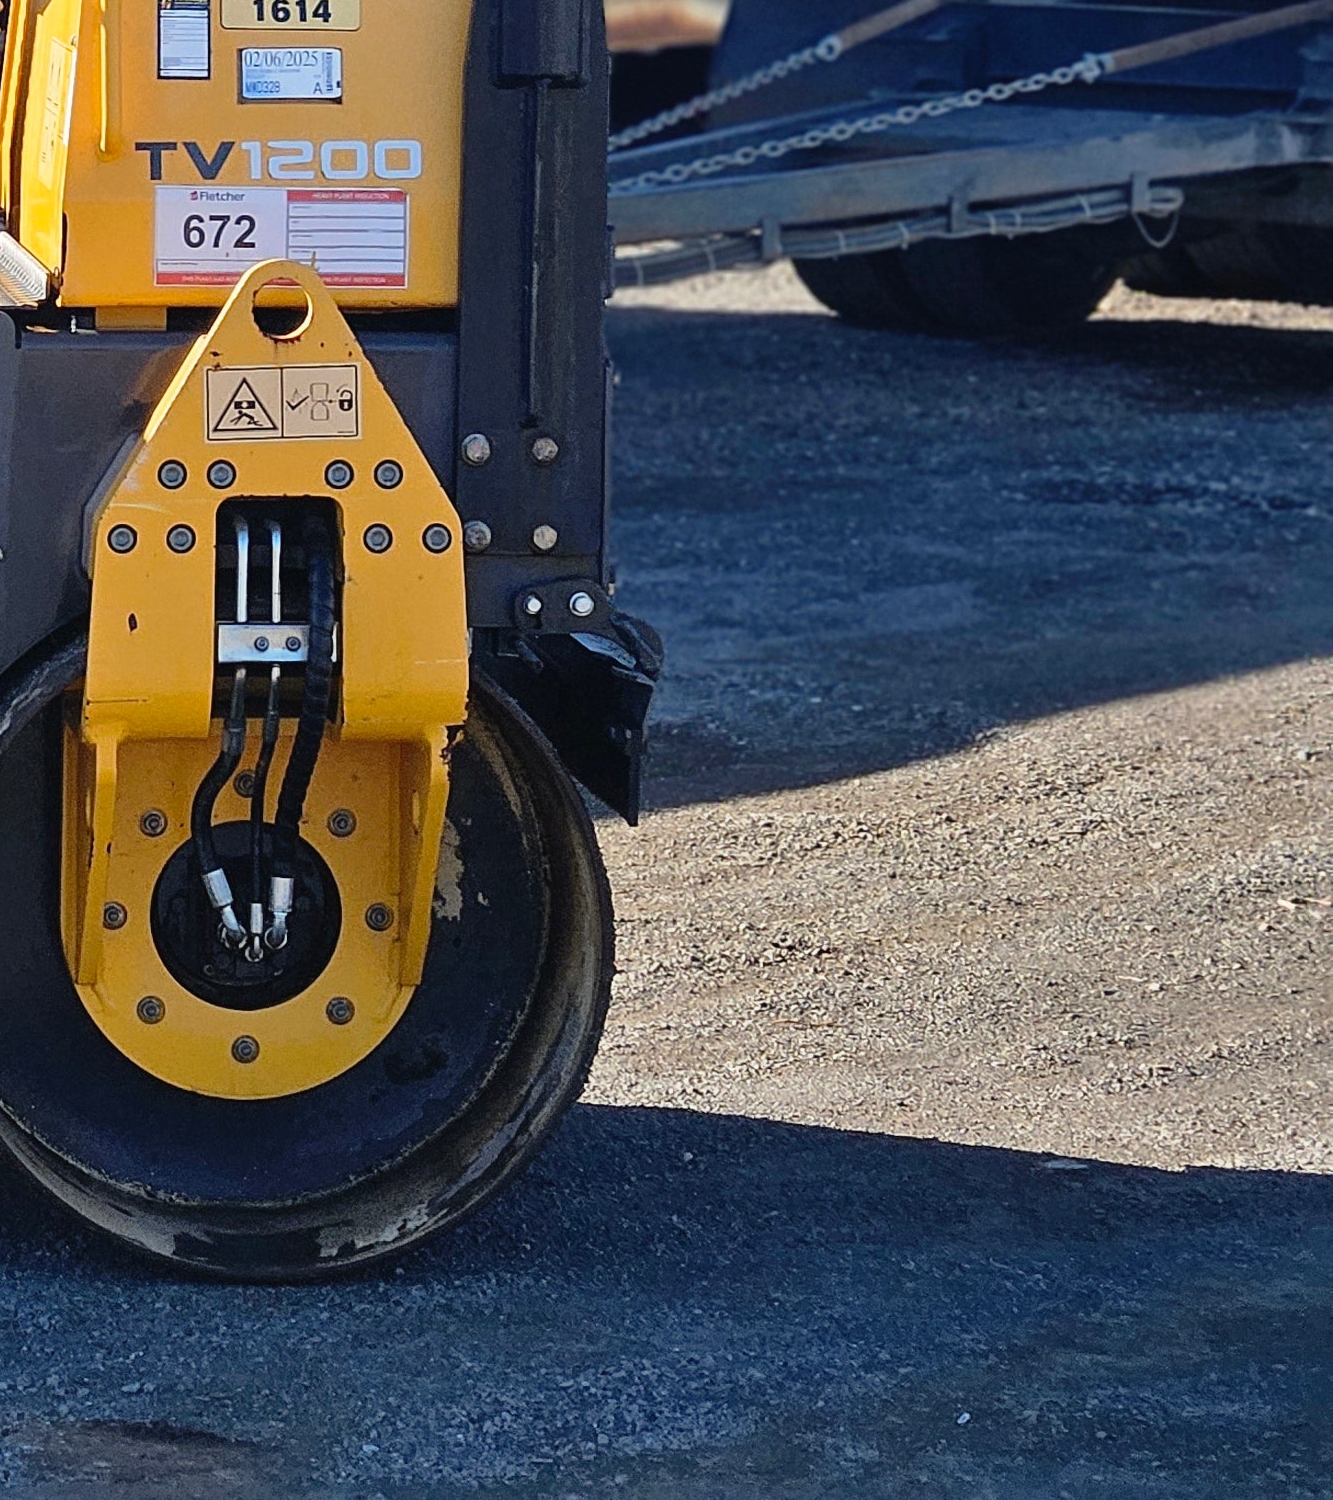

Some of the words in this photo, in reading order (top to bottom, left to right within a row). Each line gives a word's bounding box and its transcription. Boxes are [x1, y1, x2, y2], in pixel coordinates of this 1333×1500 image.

[244, 50, 318, 67] 02/06/2025
[134, 139, 422, 181] TV1200
[200, 191, 245, 202] Fletcher
[183, 214, 256, 249] 672
